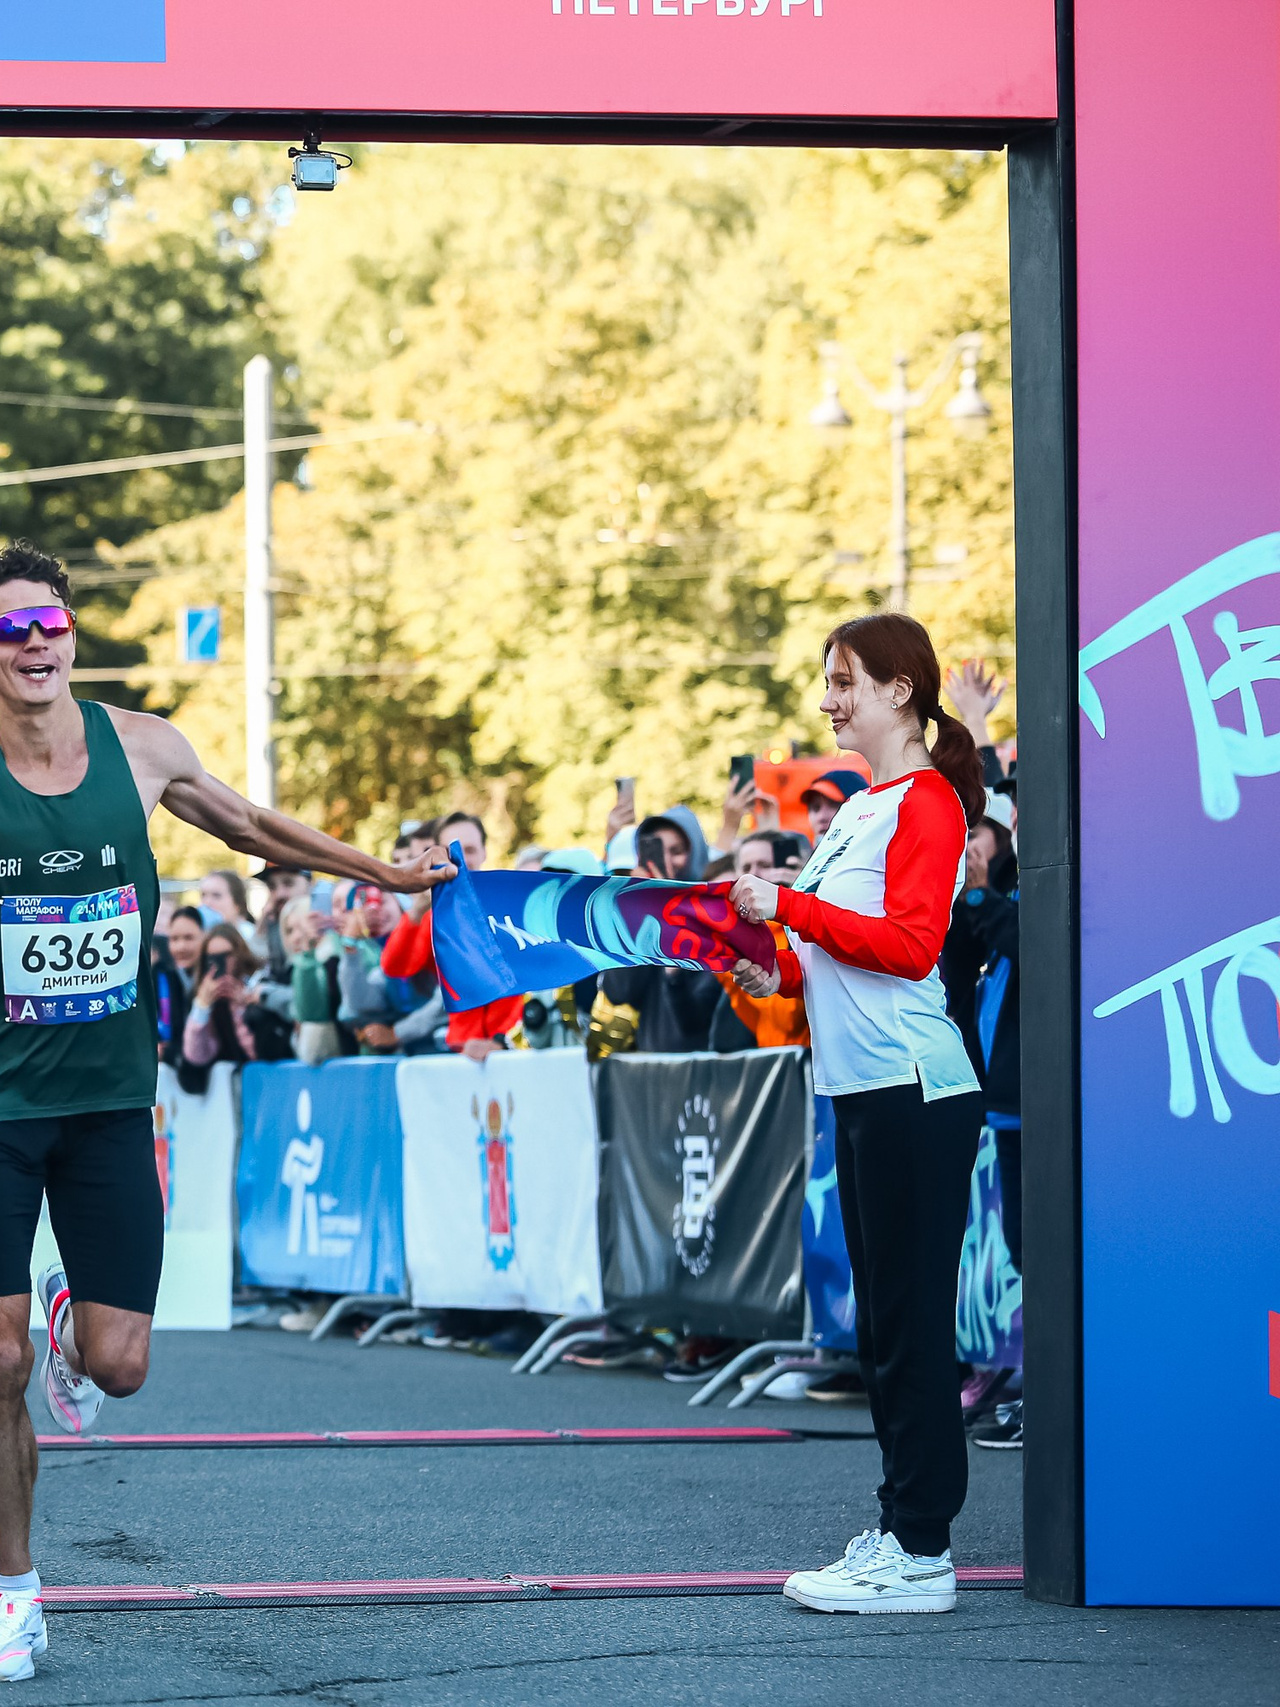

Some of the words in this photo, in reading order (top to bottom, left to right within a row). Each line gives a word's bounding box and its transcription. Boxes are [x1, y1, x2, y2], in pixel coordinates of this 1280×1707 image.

[42, 864, 82, 875] CHERY
[16, 898, 42, 907] ПОЛУ
[16, 906, 63, 915] МАРАФОН
[21, 928, 124, 973] 6363
[41, 970, 108, 990] ДМИТРИЙ
